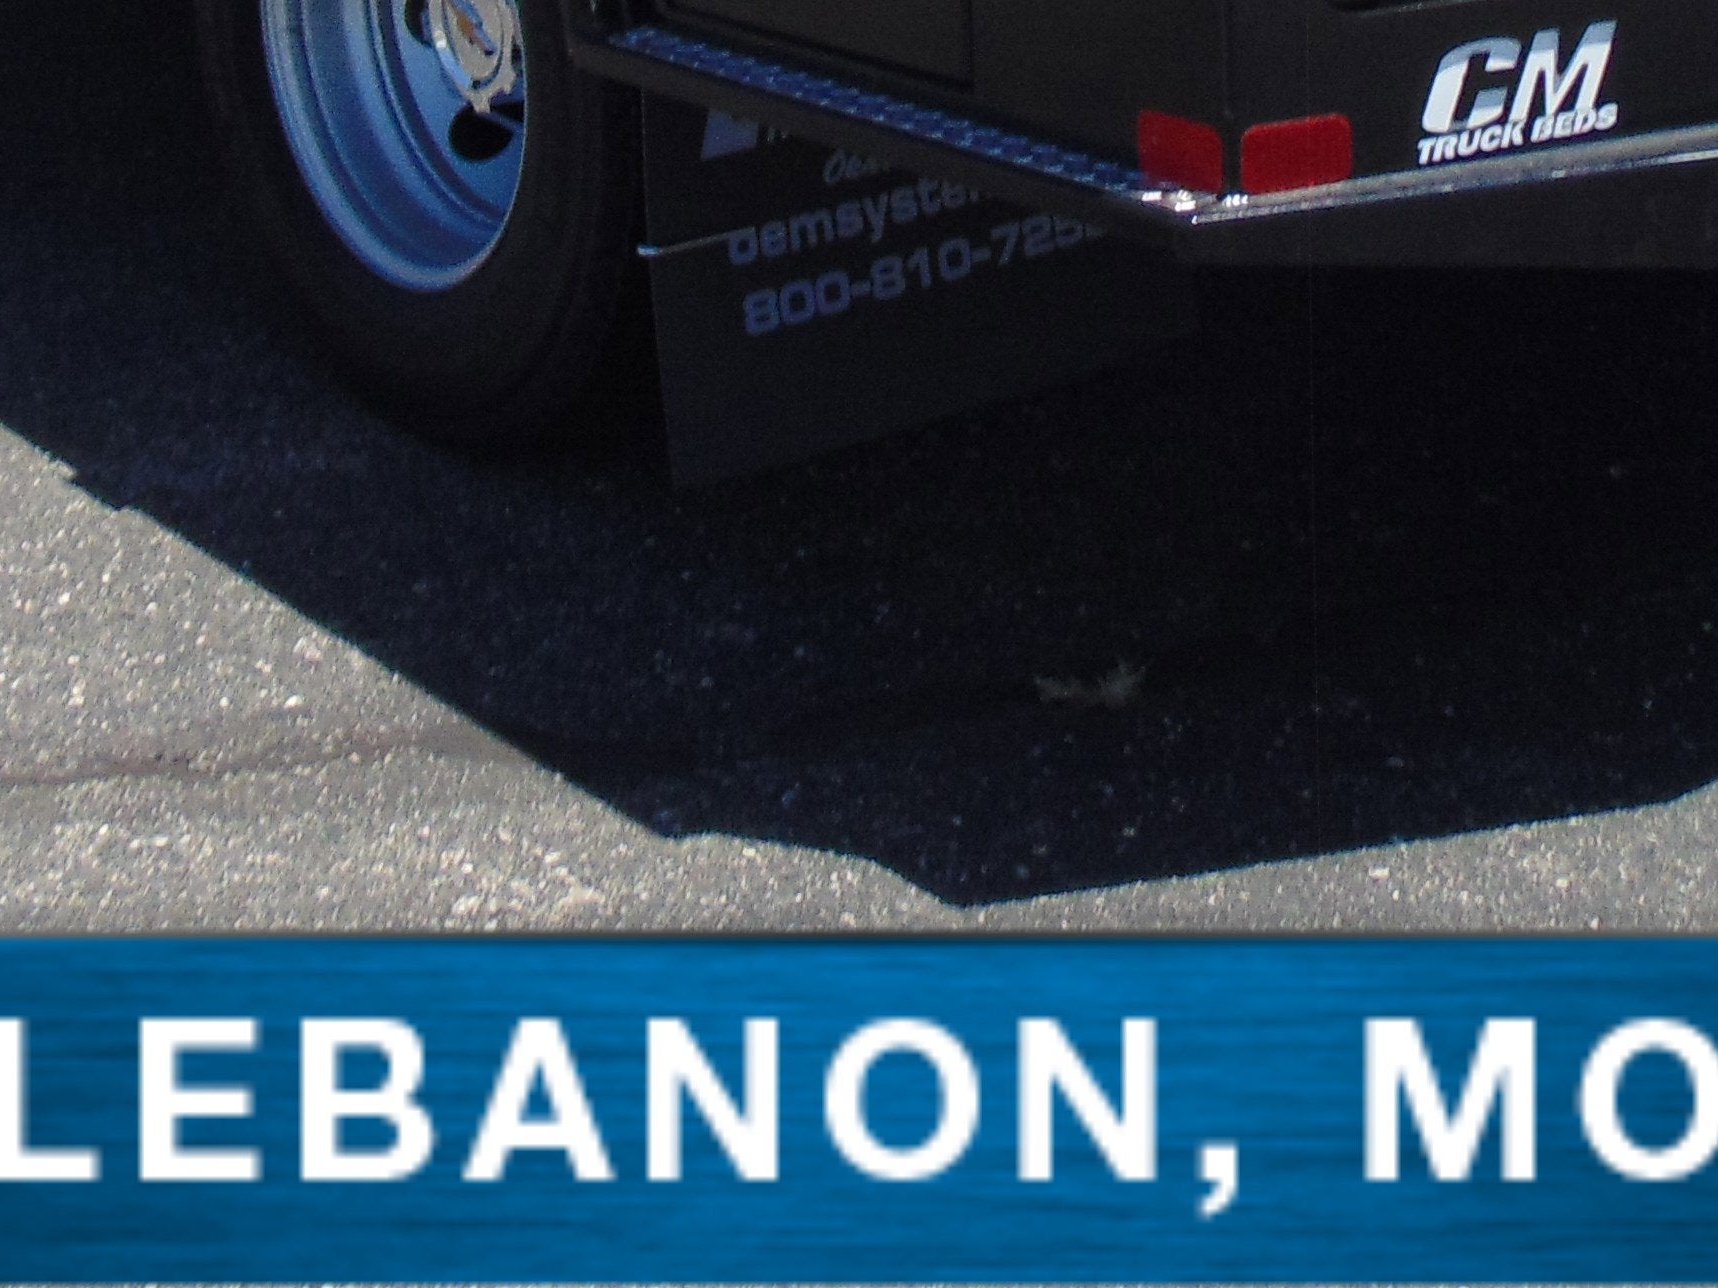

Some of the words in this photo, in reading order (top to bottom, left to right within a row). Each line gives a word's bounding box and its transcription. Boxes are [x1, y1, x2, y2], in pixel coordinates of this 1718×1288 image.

[1421, 19, 1617, 133] CM
[1417, 122, 1524, 165] TRUCK
[1530, 102, 1619, 143] BEDS
[743, 214, 1105, 336] 800-810-725
